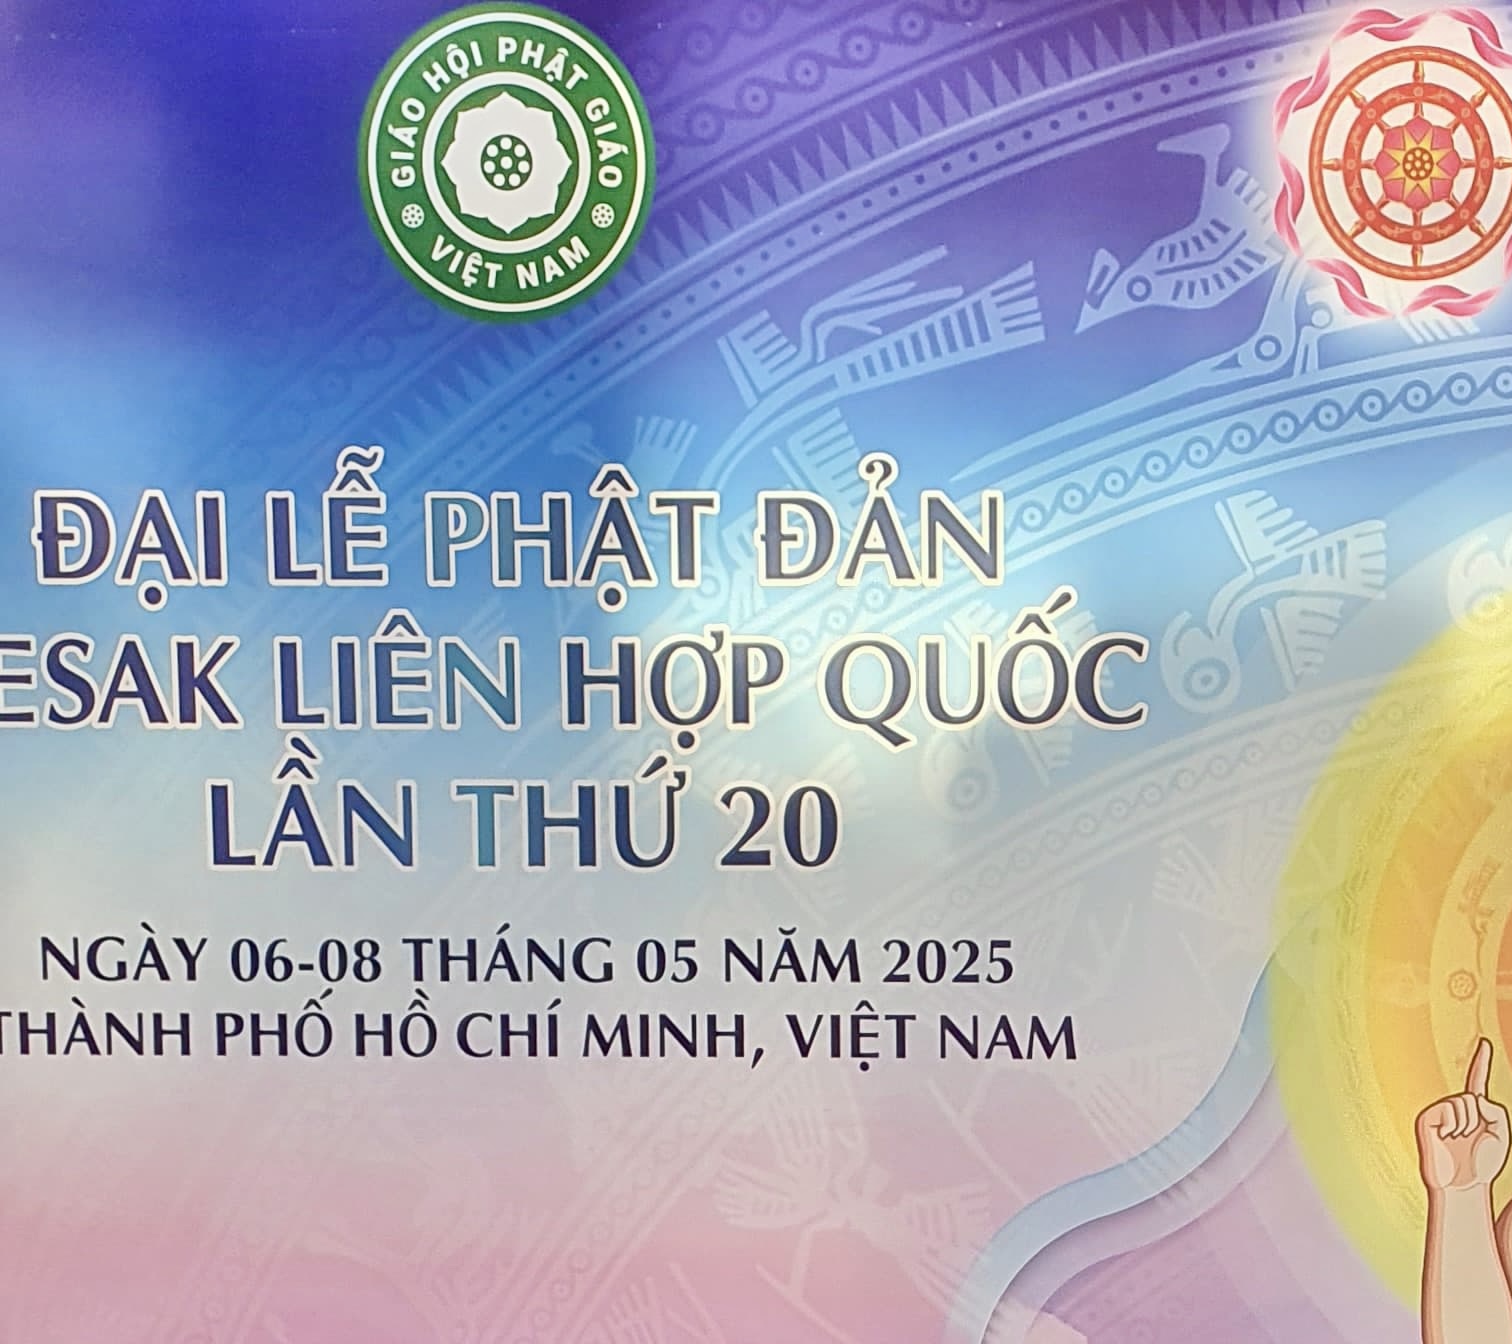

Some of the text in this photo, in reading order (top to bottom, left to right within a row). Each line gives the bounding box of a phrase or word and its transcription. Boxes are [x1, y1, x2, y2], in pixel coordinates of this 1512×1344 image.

[387, 36, 629, 188] GIÁO HỘI PHẬT GIÁO
[431, 234, 591, 289] VIỆT NAM
[32, 445, 1003, 610] ĐẠI LỄ PHẬT ĐẢN
[274, 608, 518, 730] LIÊN
[562, 625, 786, 752] HỢP
[818, 587, 1148, 751] QUỐC
[206, 736, 841, 873] LẦN THỨ 20
[40, 922, 1015, 985] NGÀY 06-08 THÁNG 05 NĂM 2025
[216, 988, 333, 1058] PHỐ
[354, 990, 437, 1058] HỒ
[457, 1000, 561, 1058] CHÍ
[583, 1011, 764, 1069] MINH,
[787, 1000, 914, 1071] VIỆT
[937, 1014, 1078, 1061] NAM
